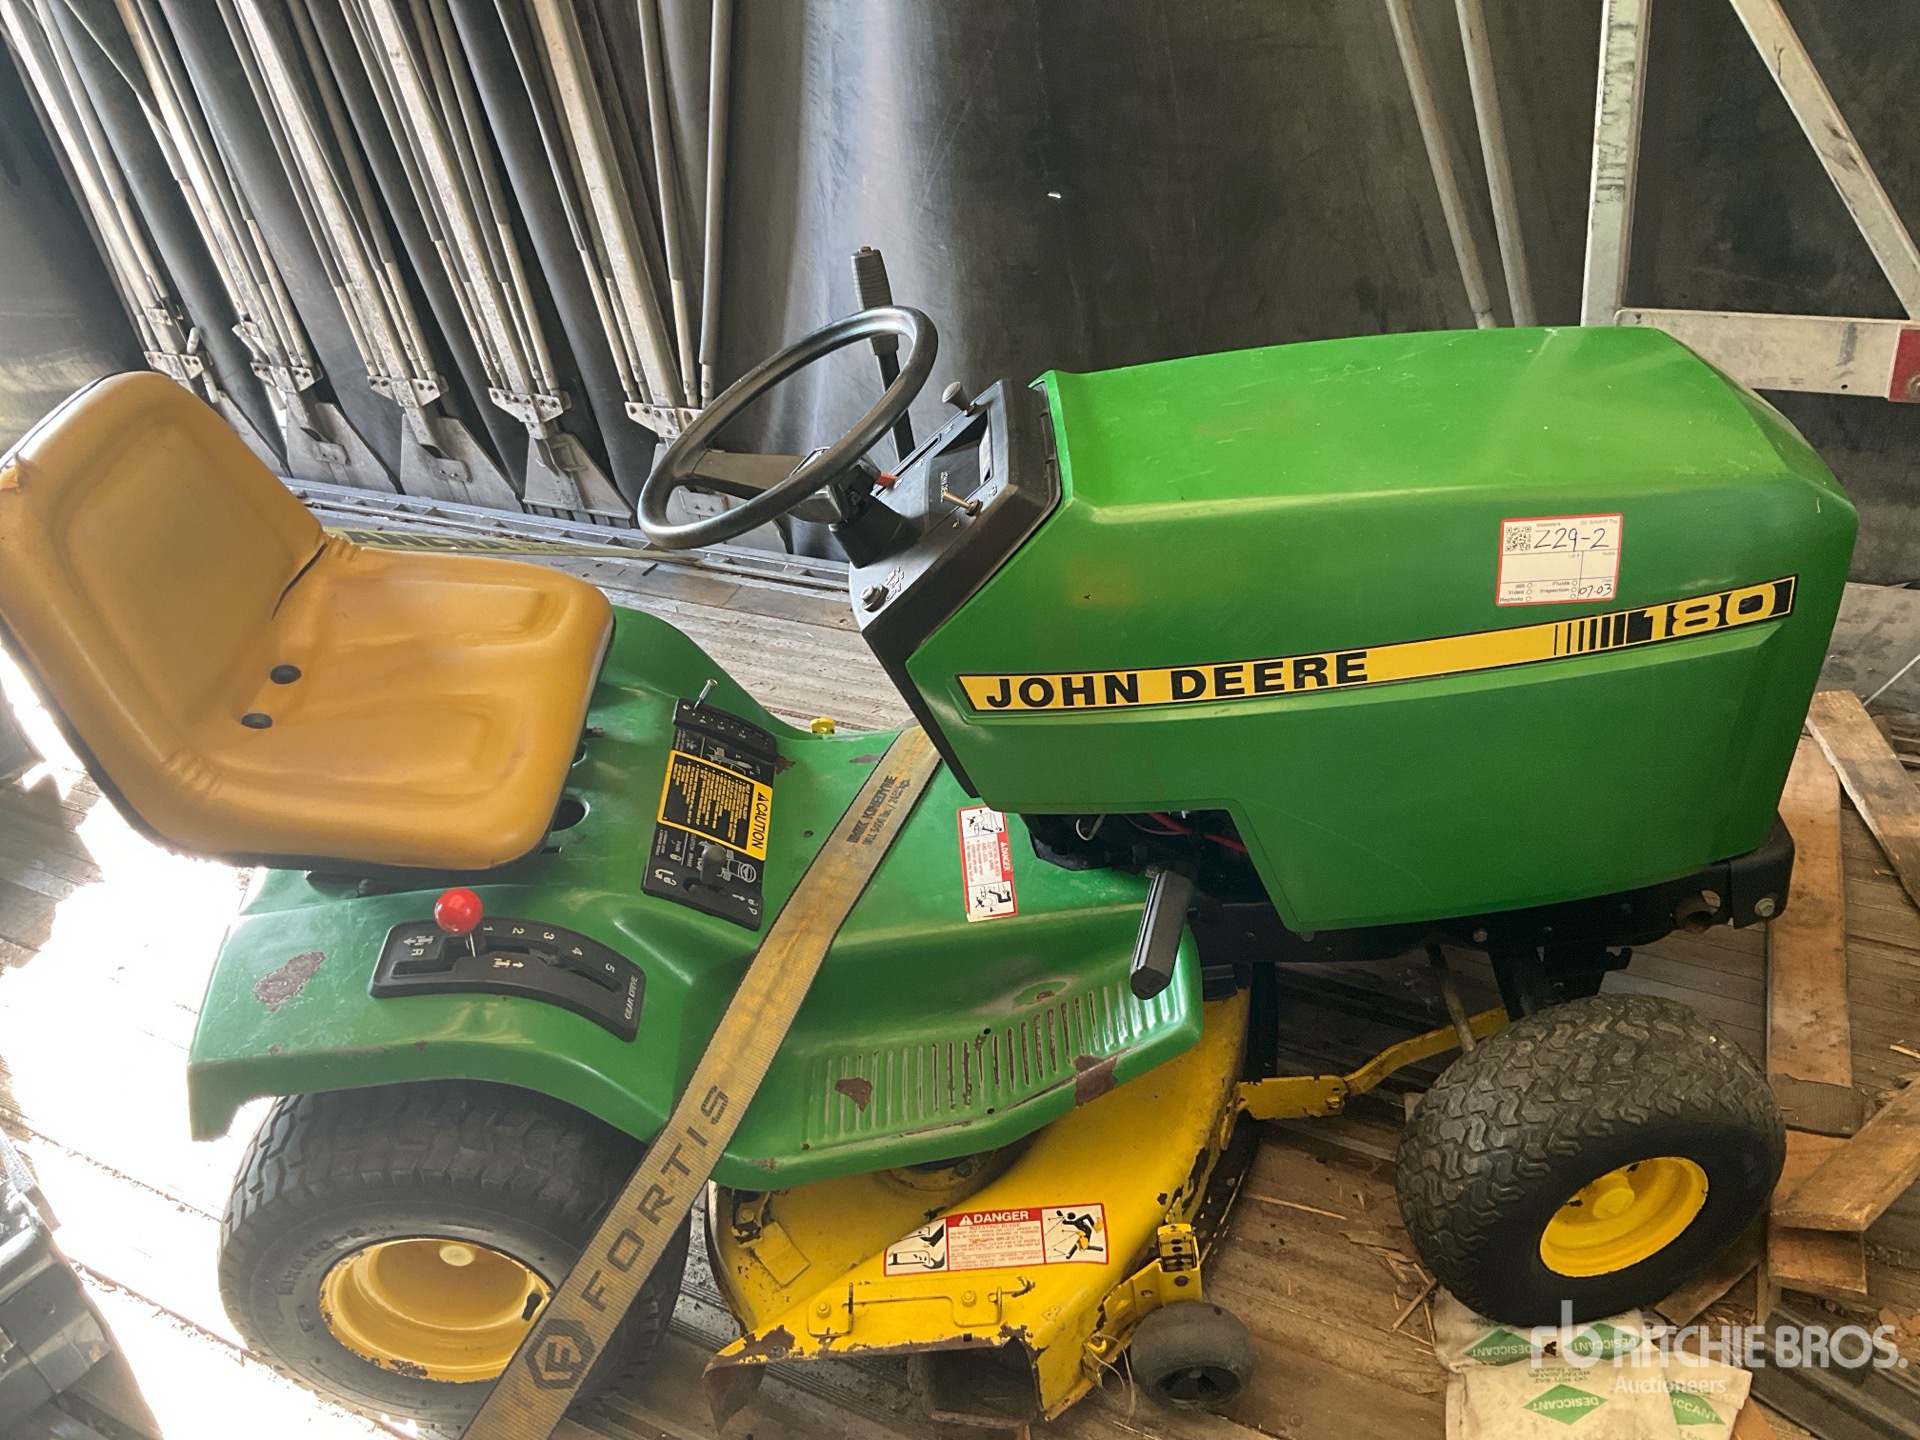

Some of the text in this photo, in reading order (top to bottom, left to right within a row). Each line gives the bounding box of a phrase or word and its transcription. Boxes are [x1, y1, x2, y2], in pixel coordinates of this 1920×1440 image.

[1533, 527, 1609, 552] Z29-2
[1643, 583, 1776, 641] 180
[986, 652, 1368, 708] JOHN DEERE
[751, 800, 769, 850] CAUTION
[1001, 848, 1011, 872] DANGER
[748, 907, 757, 915] P
[512, 927, 524, 935] 2
[543, 931, 555, 940] 3
[411, 948, 424, 956] R
[571, 947, 583, 956] 4
[605, 963, 615, 973] 5
[624, 975, 639, 1020] GEAR DRIVE
[581, 1084, 729, 1312] FORTIS
[973, 1210, 1029, 1223] DANGER
[1574, 1337, 1637, 1353] DESICCANT
[1532, 1396, 1600, 1411] DESICCANT
[1672, 1397, 1717, 1422] ICCANT
